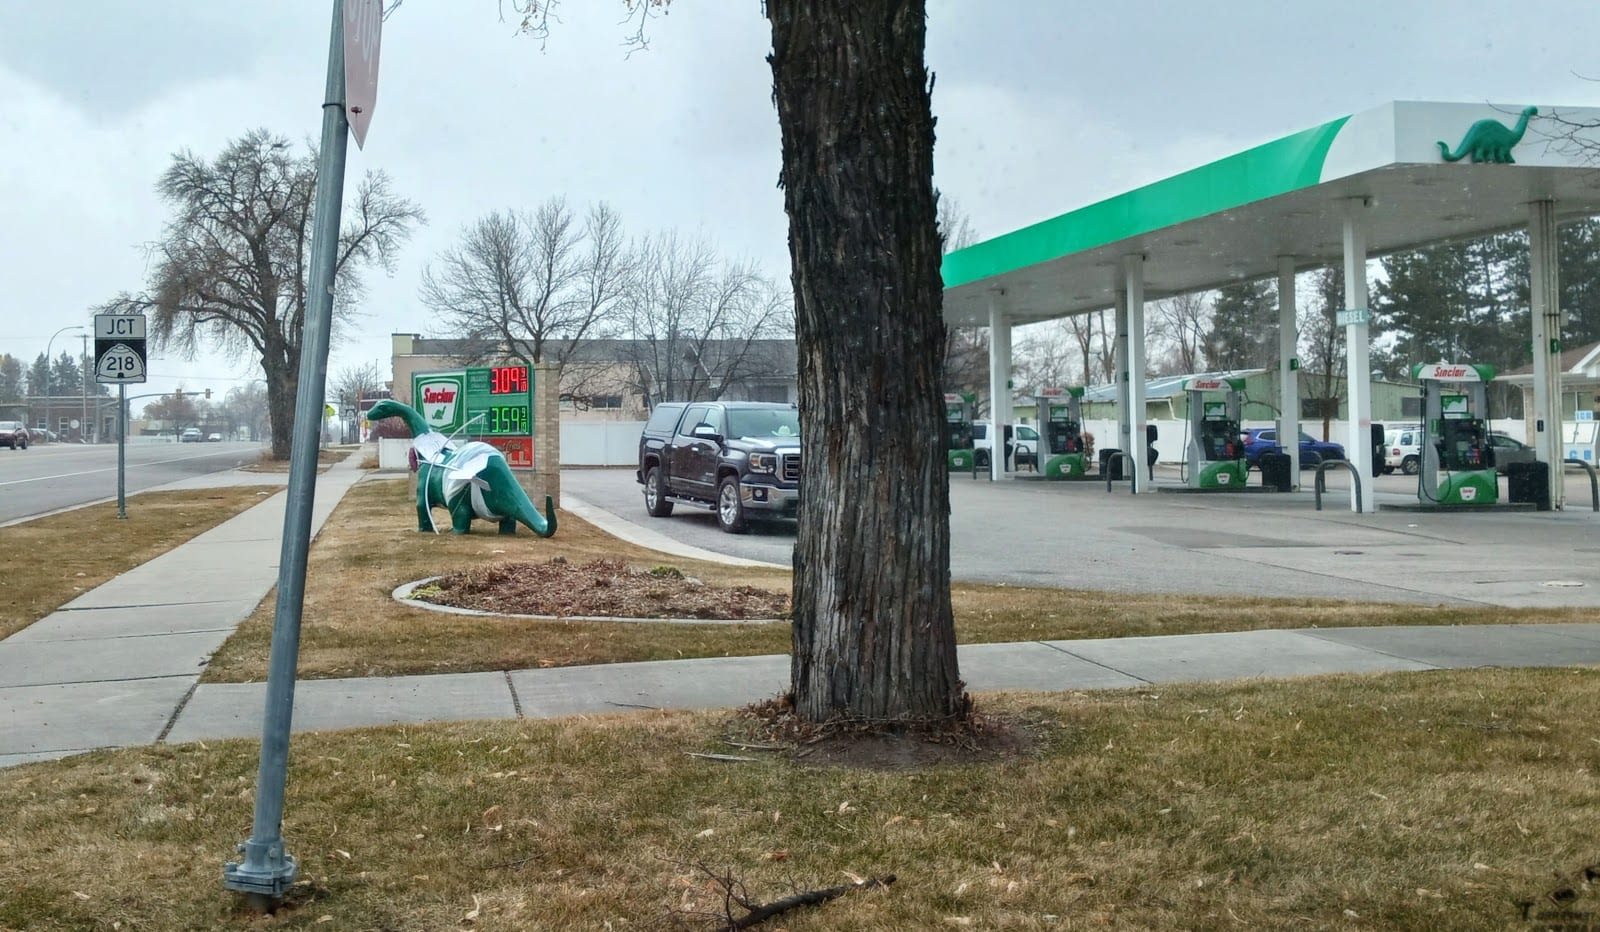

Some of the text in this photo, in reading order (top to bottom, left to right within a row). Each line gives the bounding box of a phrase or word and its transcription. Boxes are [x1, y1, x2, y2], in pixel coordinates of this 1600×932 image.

[106, 318, 135, 335] JCT
[106, 356, 135, 371] 218
[1434, 366, 1466, 377] Sinclair
[491, 367, 519, 394] 3.09
[423, 387, 456, 404] Sinclair
[491, 407, 519, 433] 3.59
